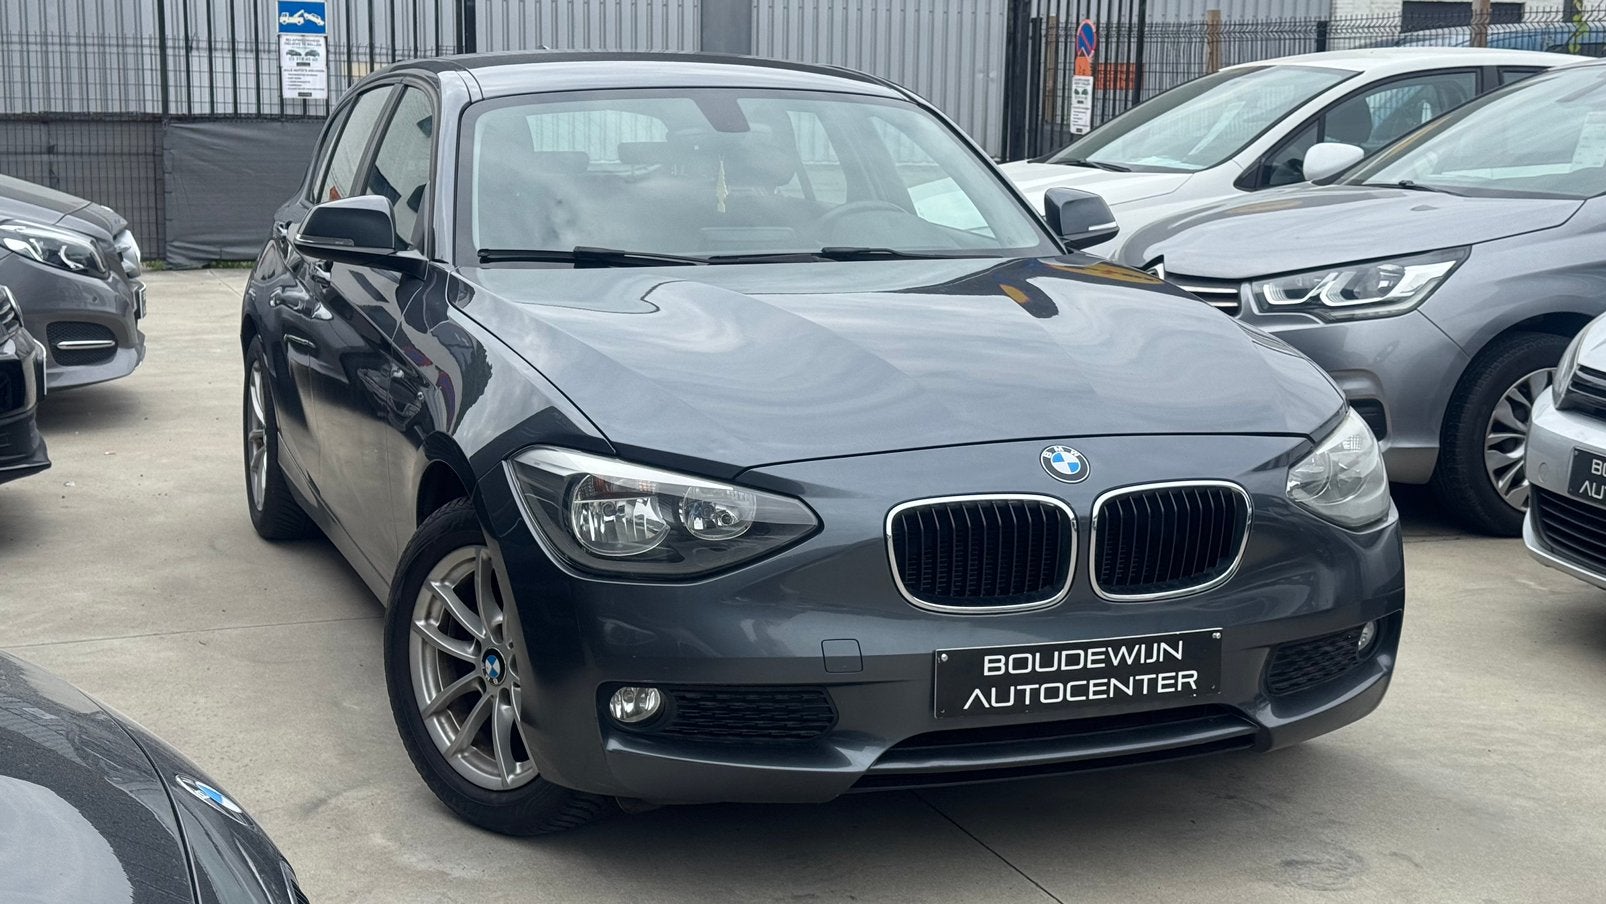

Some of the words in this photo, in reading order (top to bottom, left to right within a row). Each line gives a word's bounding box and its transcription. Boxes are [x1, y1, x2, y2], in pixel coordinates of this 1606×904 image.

[1042, 446, 1081, 459] BMW
[983, 640, 1184, 676] BOUDEWIJN
[963, 670, 1198, 710] AUTOCENTER
